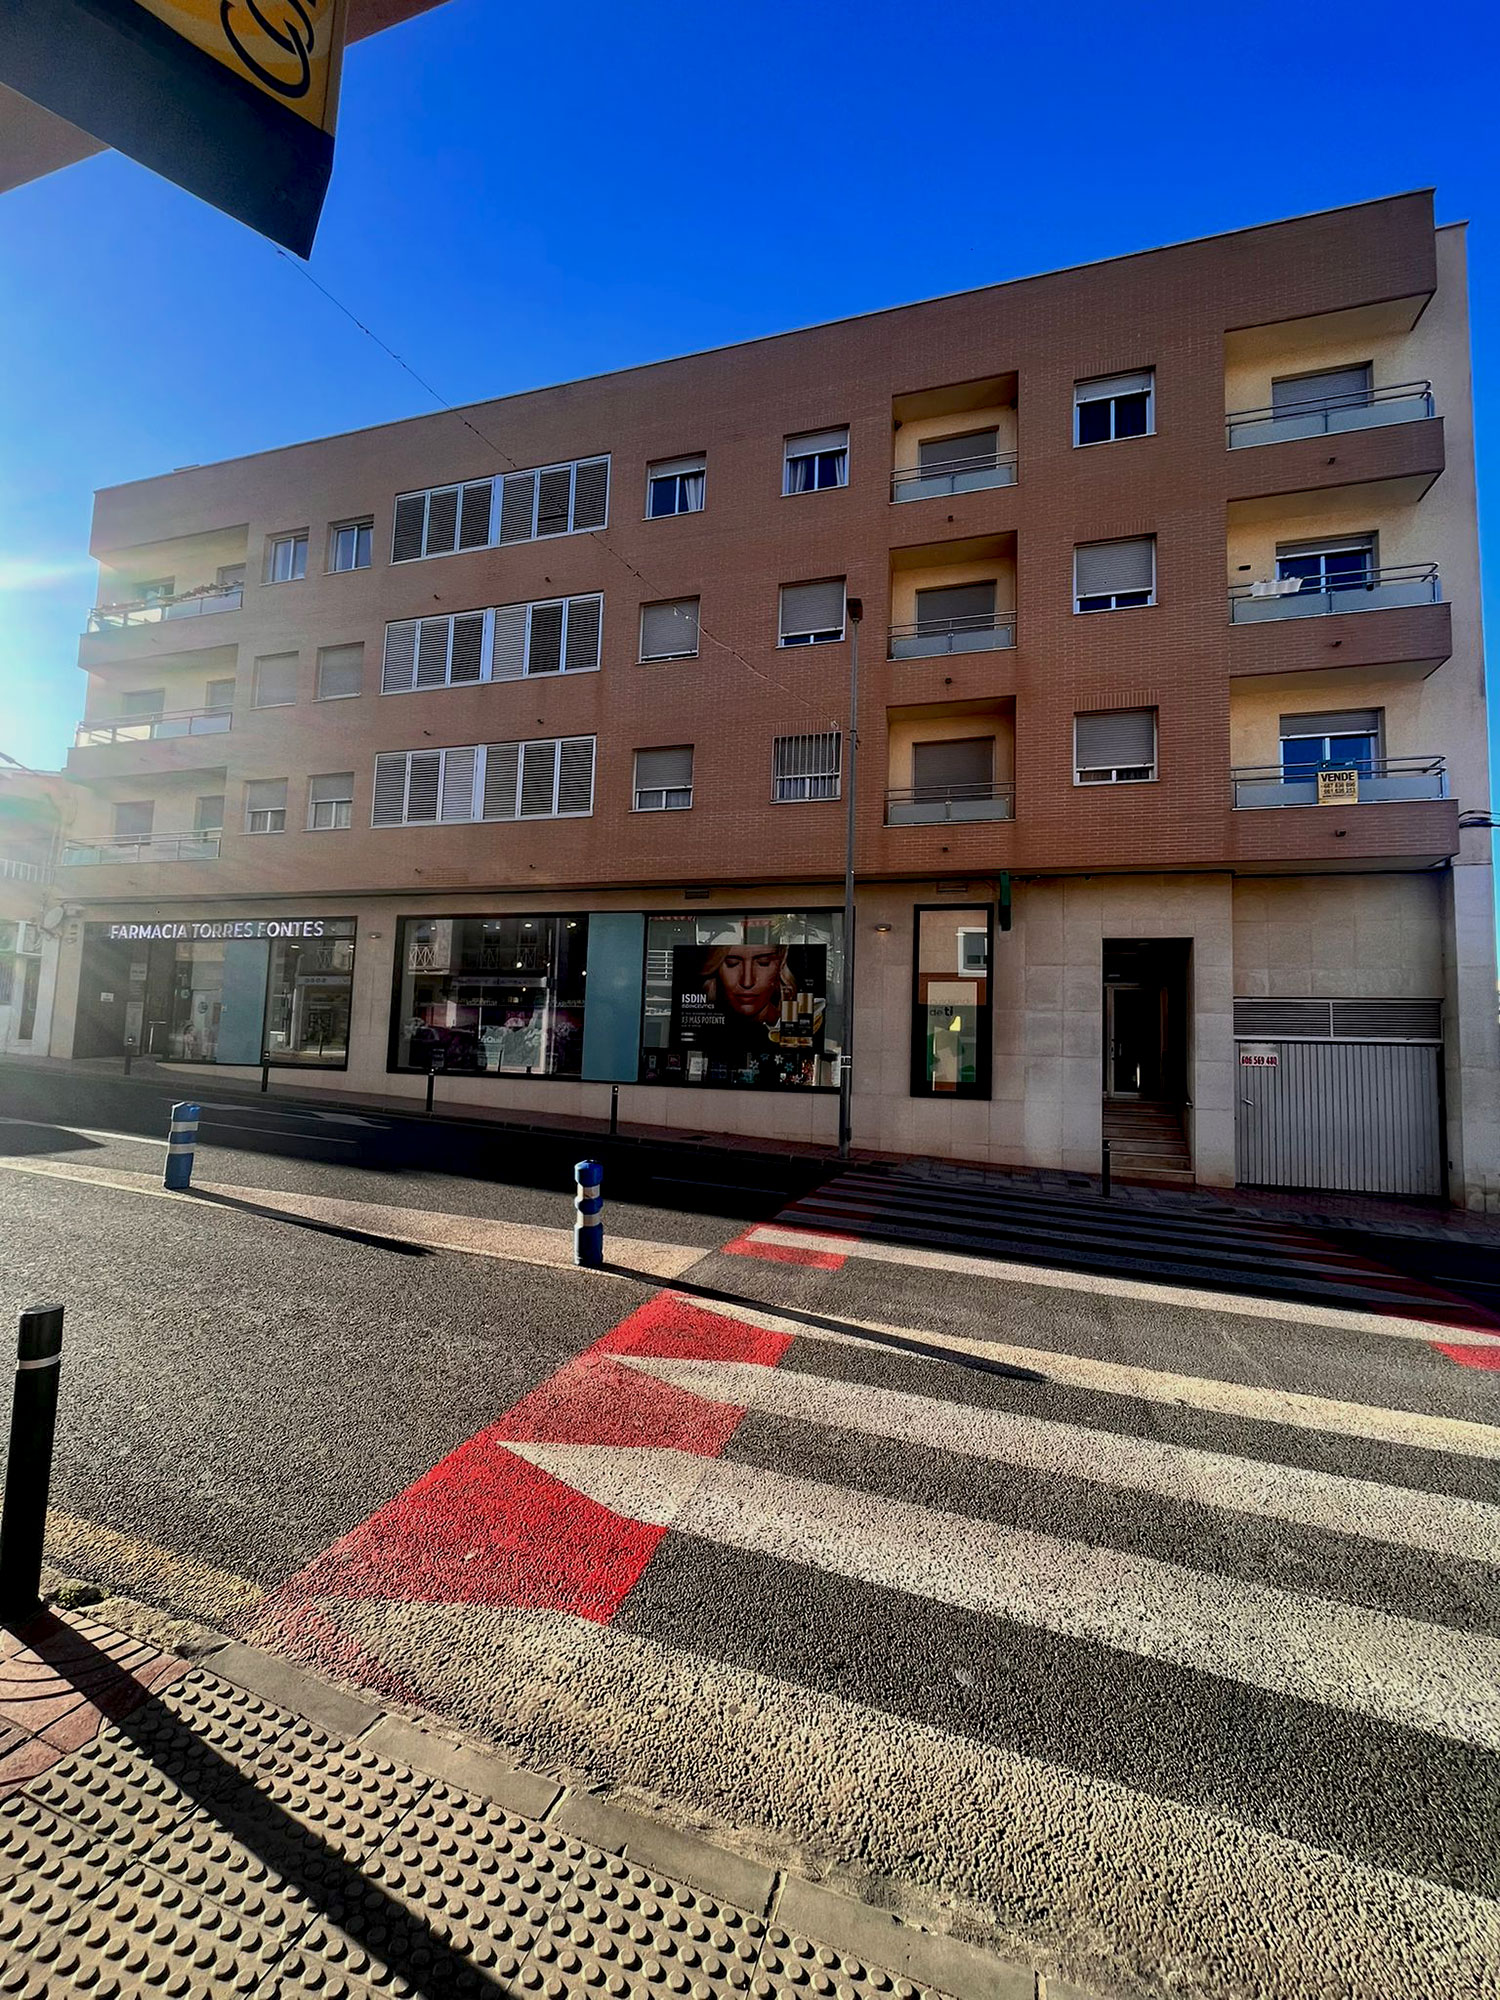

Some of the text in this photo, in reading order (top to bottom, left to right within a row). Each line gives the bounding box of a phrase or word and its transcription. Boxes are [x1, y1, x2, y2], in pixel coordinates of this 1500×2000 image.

[1321, 772, 1355, 782] VENDE
[110, 921, 324, 939] FARMACIA TORRES FONTES
[681, 993, 707, 1004] ISDIN
[944, 1006, 954, 1016] ti
[701, 1016, 725, 1025] POTENTE
